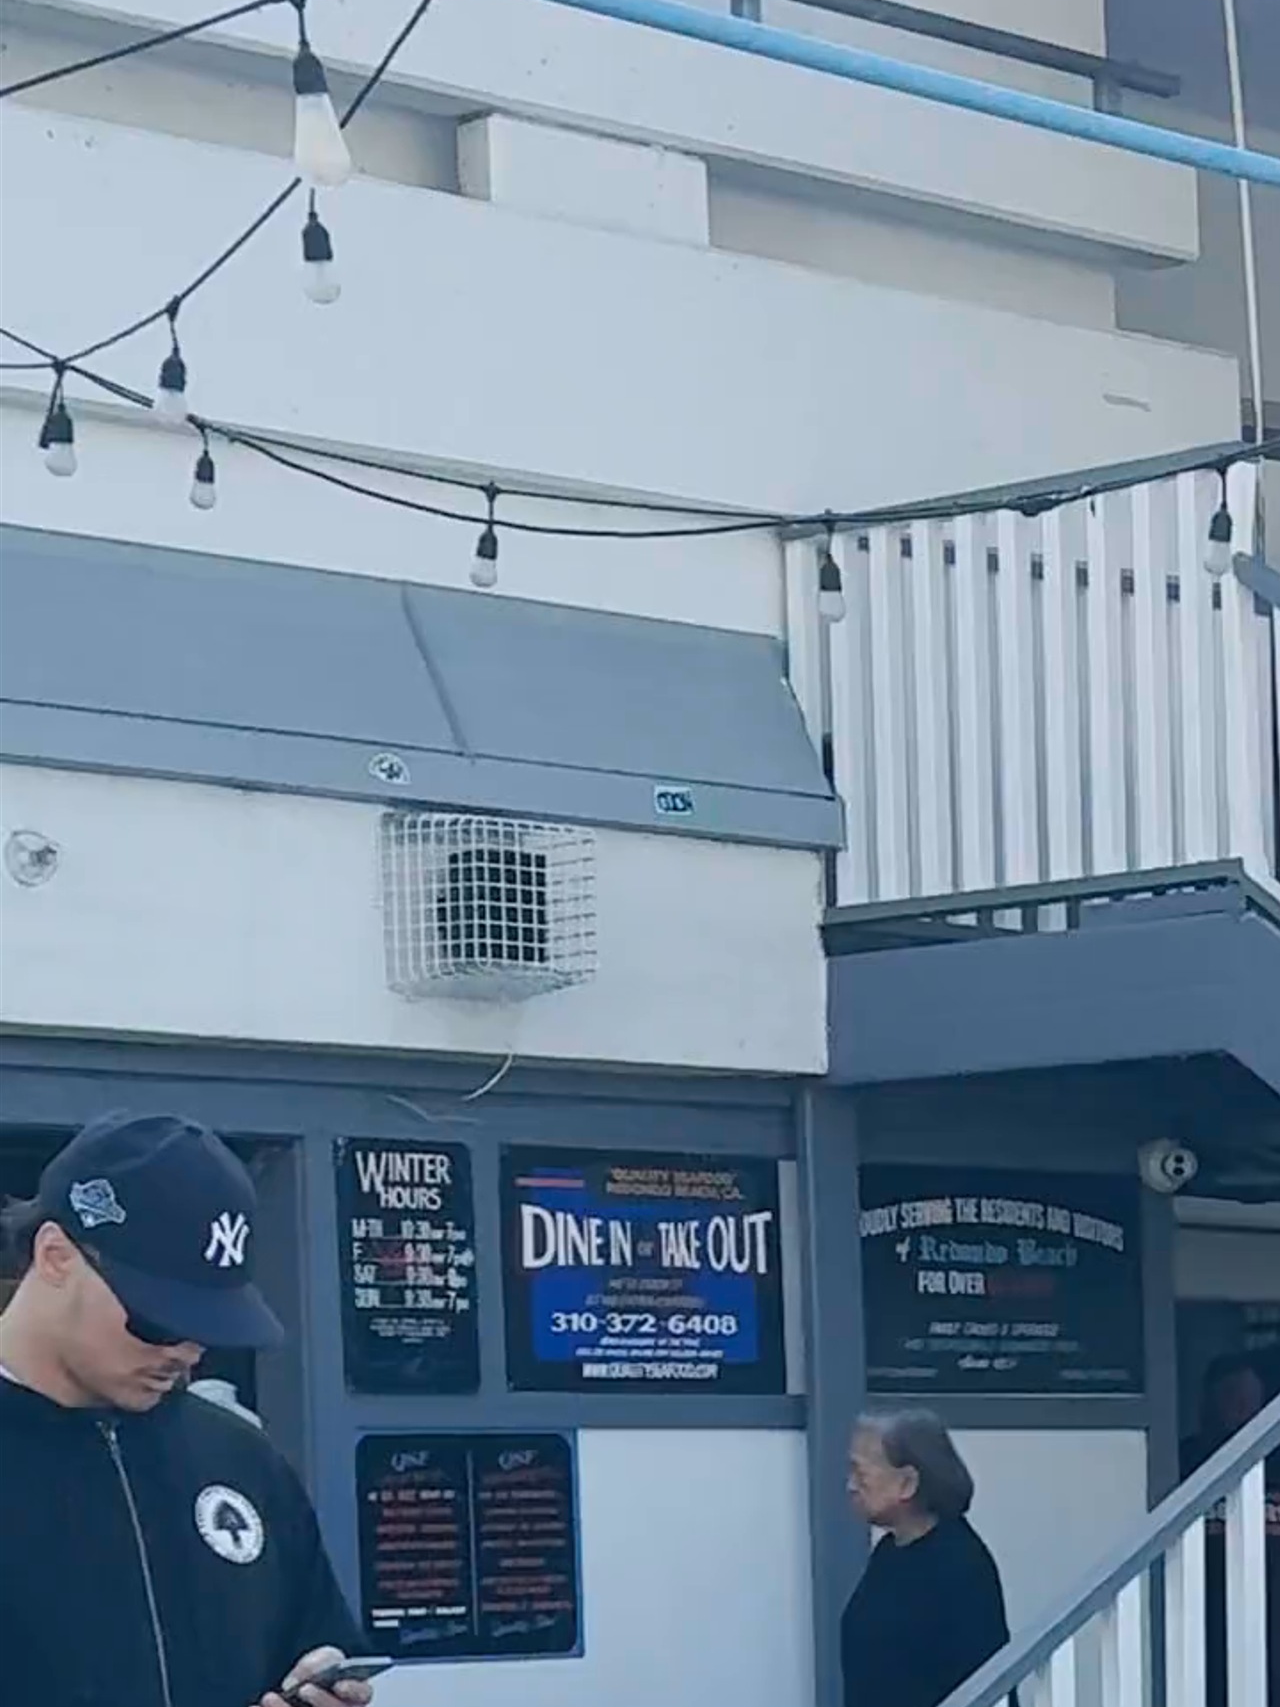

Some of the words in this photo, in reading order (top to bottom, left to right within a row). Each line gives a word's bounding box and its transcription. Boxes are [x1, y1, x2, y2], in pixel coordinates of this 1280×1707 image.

[355, 1150, 453, 1193] WINTER
[380, 1185, 442, 1211] HOURS
[859, 1204, 900, 1237] OUDLY
[900, 1196, 954, 1229] SERVING
[954, 1197, 980, 1223] THE
[981, 1197, 1046, 1230] RESIDENTS
[1046, 1206, 1072, 1235] AND
[520, 1203, 605, 1270] DINE
[609, 1220, 633, 1267] IN
[657, 1221, 702, 1270] TAKE
[707, 1210, 773, 1275] OUT
[917, 1269, 948, 1294] FOR
[948, 1270, 987, 1296] OVER
